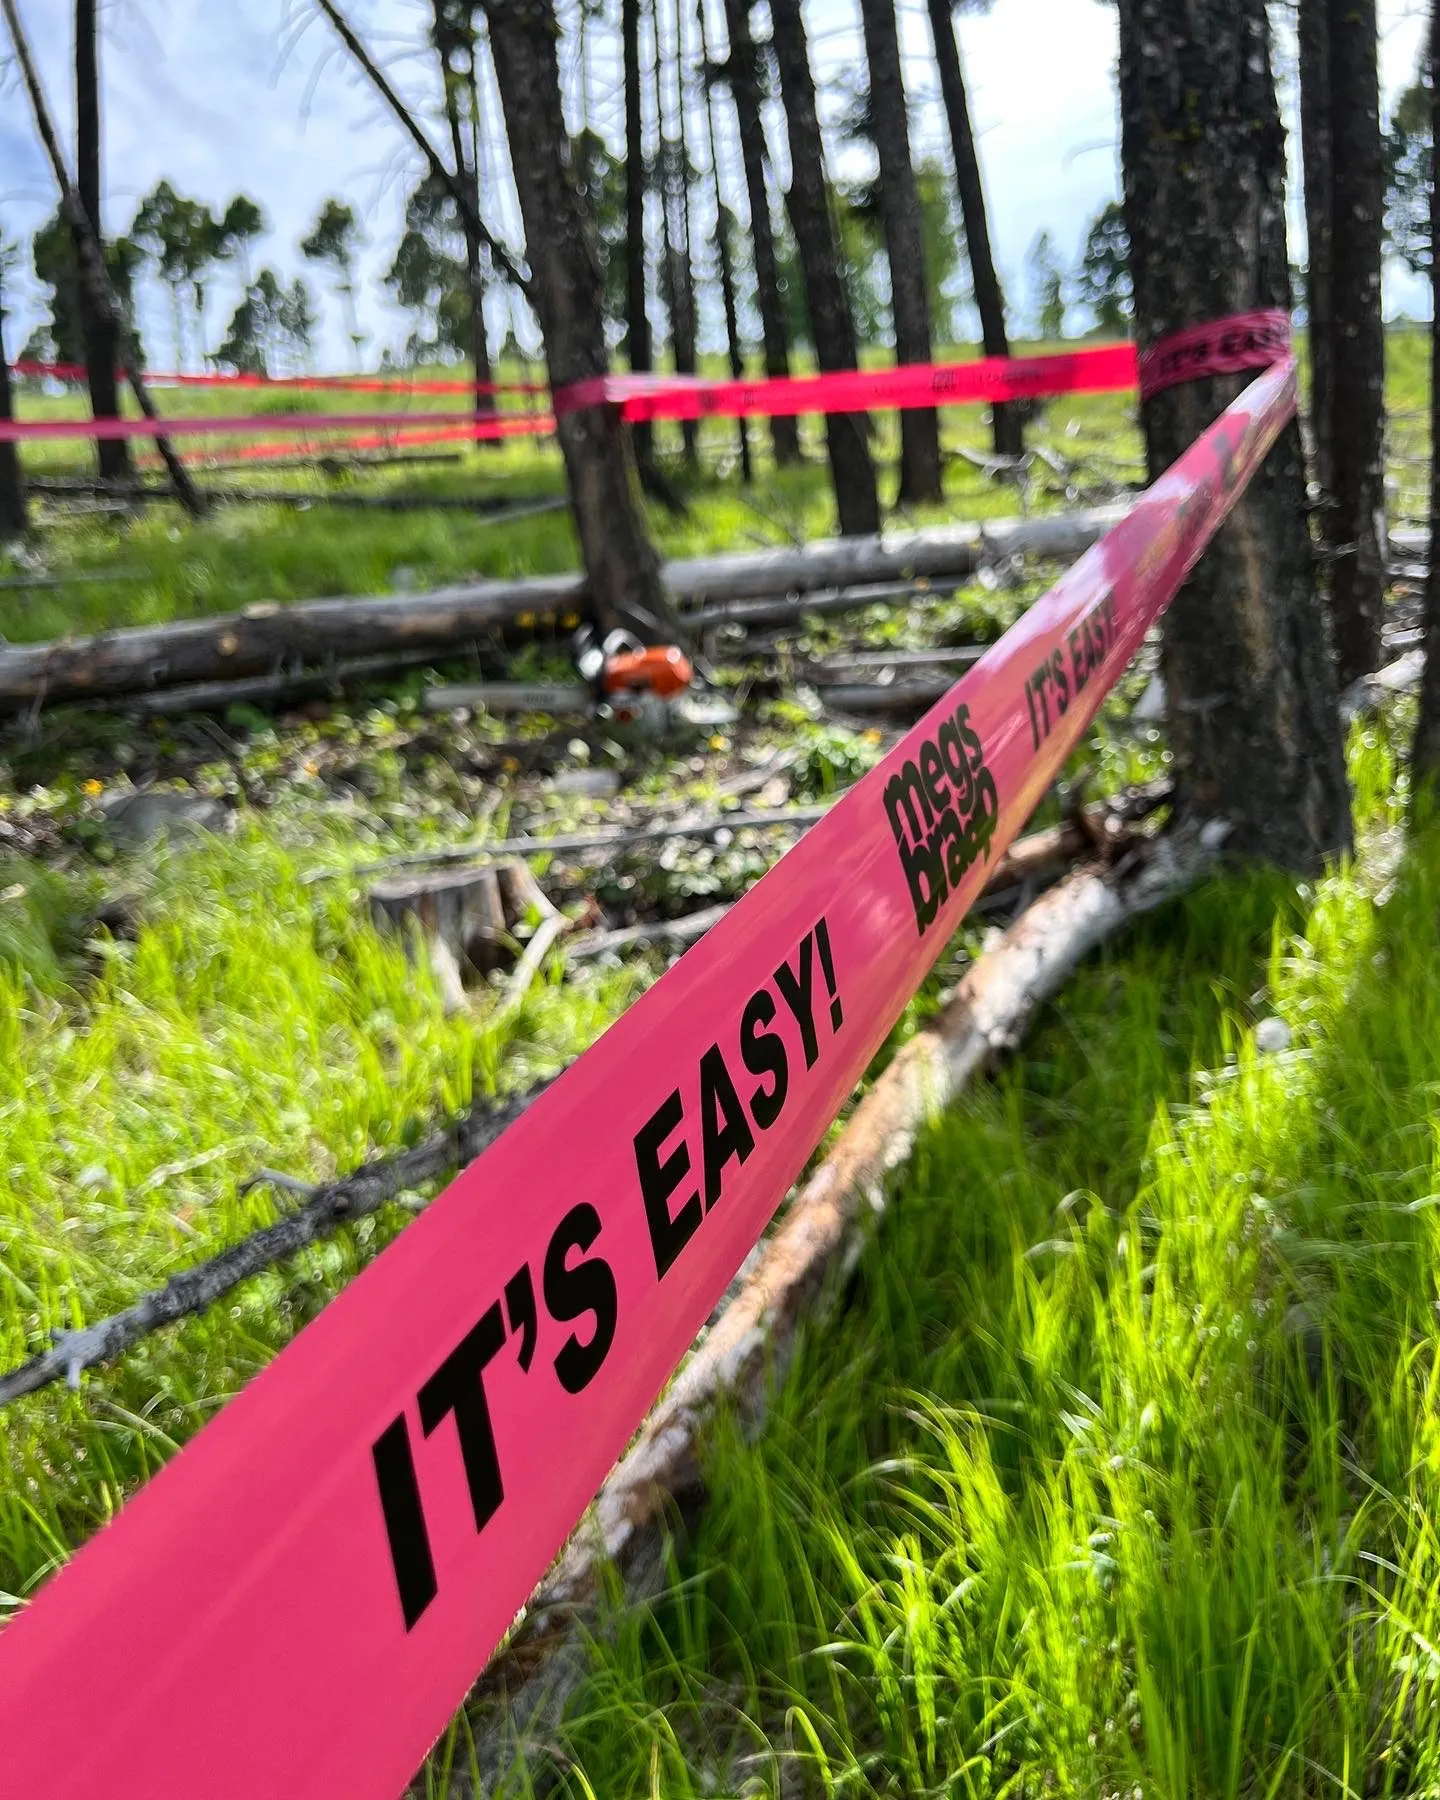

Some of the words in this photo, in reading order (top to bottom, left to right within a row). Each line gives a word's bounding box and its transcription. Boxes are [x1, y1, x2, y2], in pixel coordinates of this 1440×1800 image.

[883, 703, 982, 846] megs
[1024, 648, 1069, 752] IT'S
[898, 766, 998, 938] brap
[371, 1202, 618, 1634] IT'S
[633, 917, 844, 1282] EASY!
